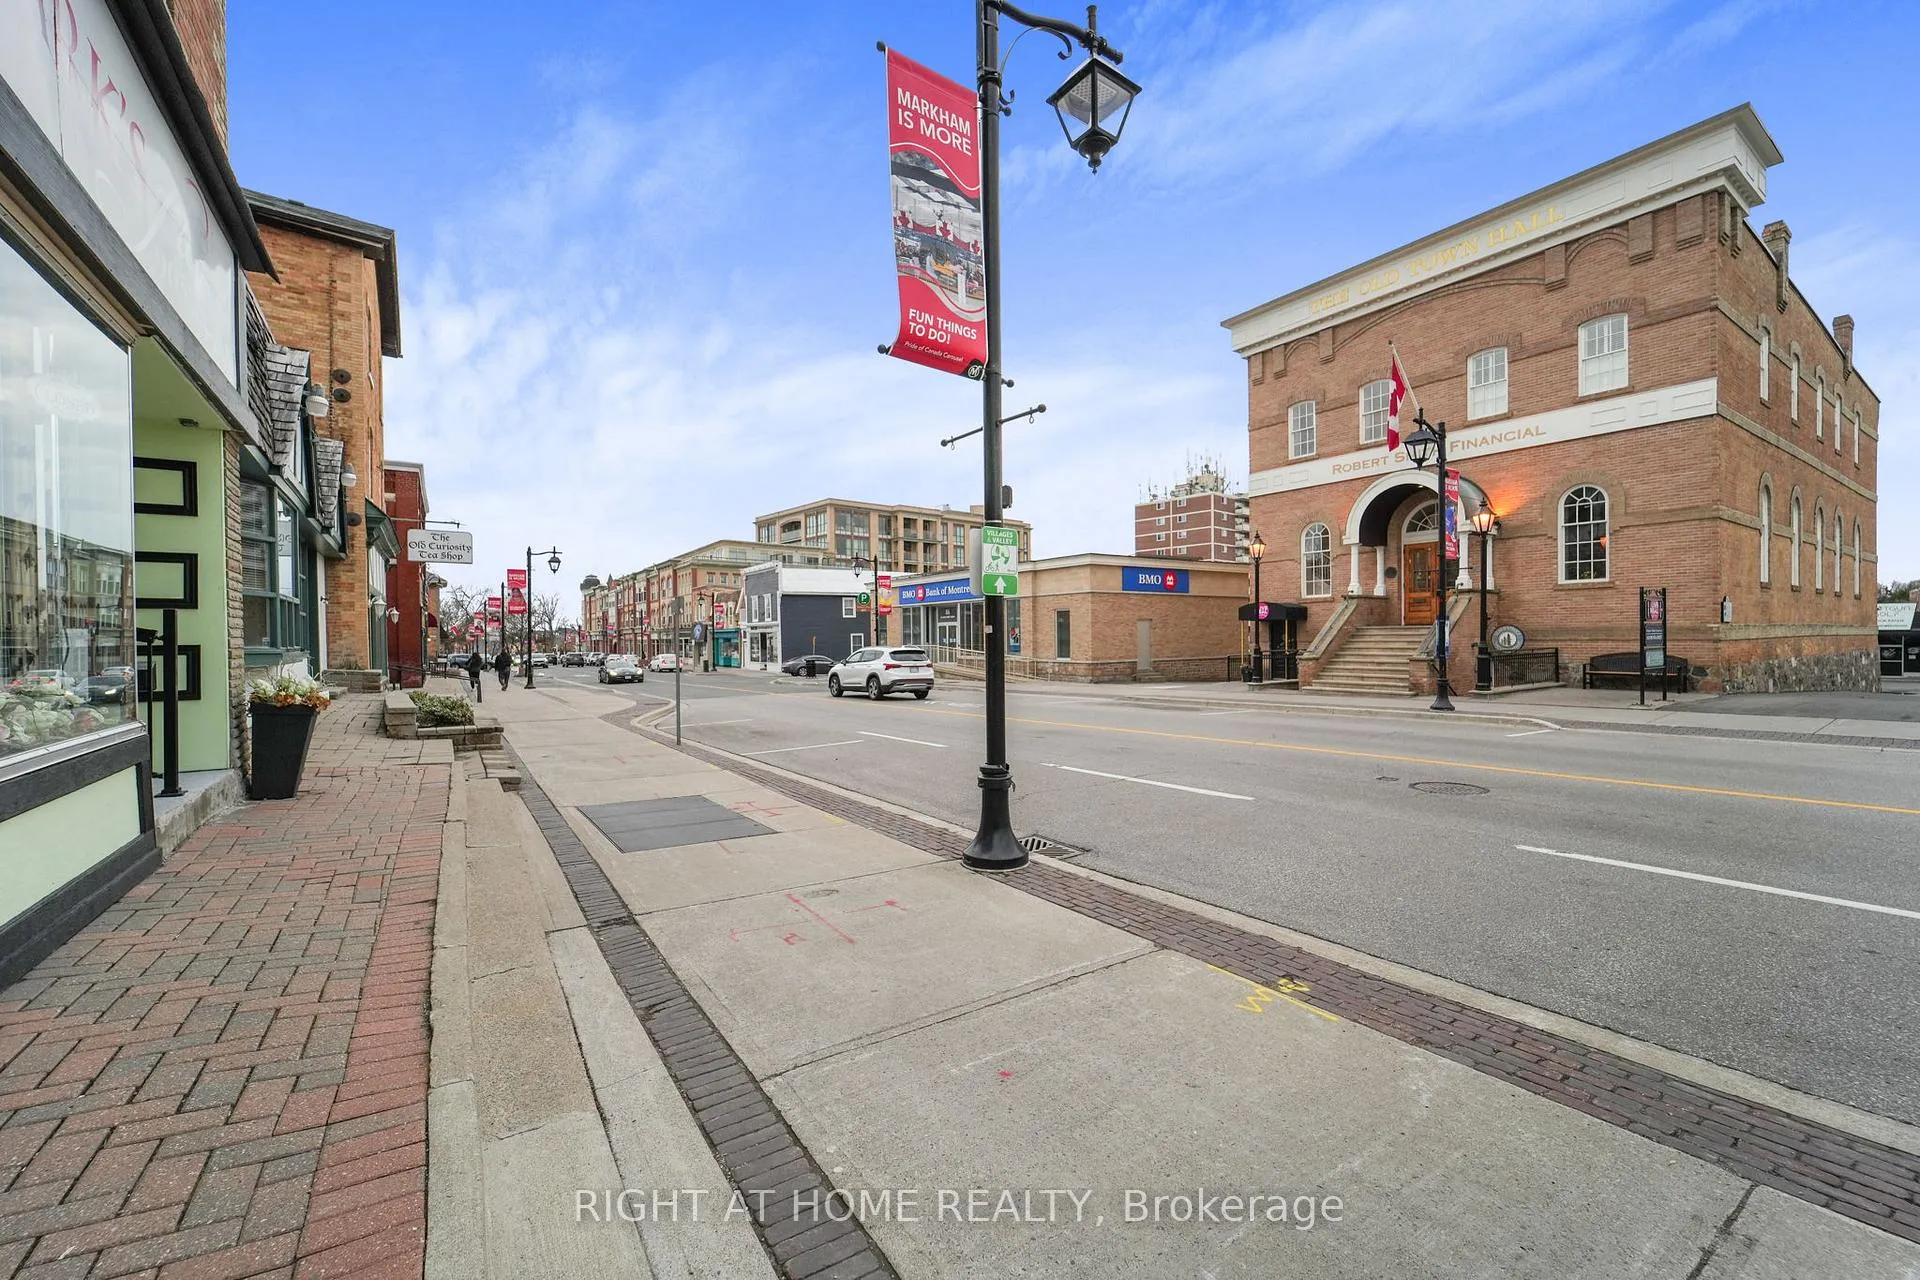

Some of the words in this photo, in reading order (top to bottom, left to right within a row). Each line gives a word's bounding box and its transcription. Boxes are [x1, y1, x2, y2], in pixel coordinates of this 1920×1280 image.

[897, 87, 971, 137] MARKHAM
[898, 107, 914, 129] IS
[919, 117, 972, 157] MORE
[1405, 235, 1482, 277] TOWN
[1487, 205, 1568, 249] HALL
[908, 308, 934, 327] FUN
[936, 316, 978, 340] THINGS
[908, 321, 926, 337] TO
[927, 327, 951, 345] DO!
[1449, 425, 1546, 453] FINANCIAL
[1331, 455, 1389, 475] ROBERT
[408, 540, 427, 549] Old
[428, 542, 472, 553] Curiosity
[430, 532, 450, 541] The
[418, 550, 438, 559] Tea
[440, 551, 463, 561] Shop
[1138, 573, 1162, 585] BMO
[861, 594, 868, 602] P
[902, 590, 916, 599] BMO
[925, 588, 940, 596] Bank
[947, 585, 971, 595] Montre
